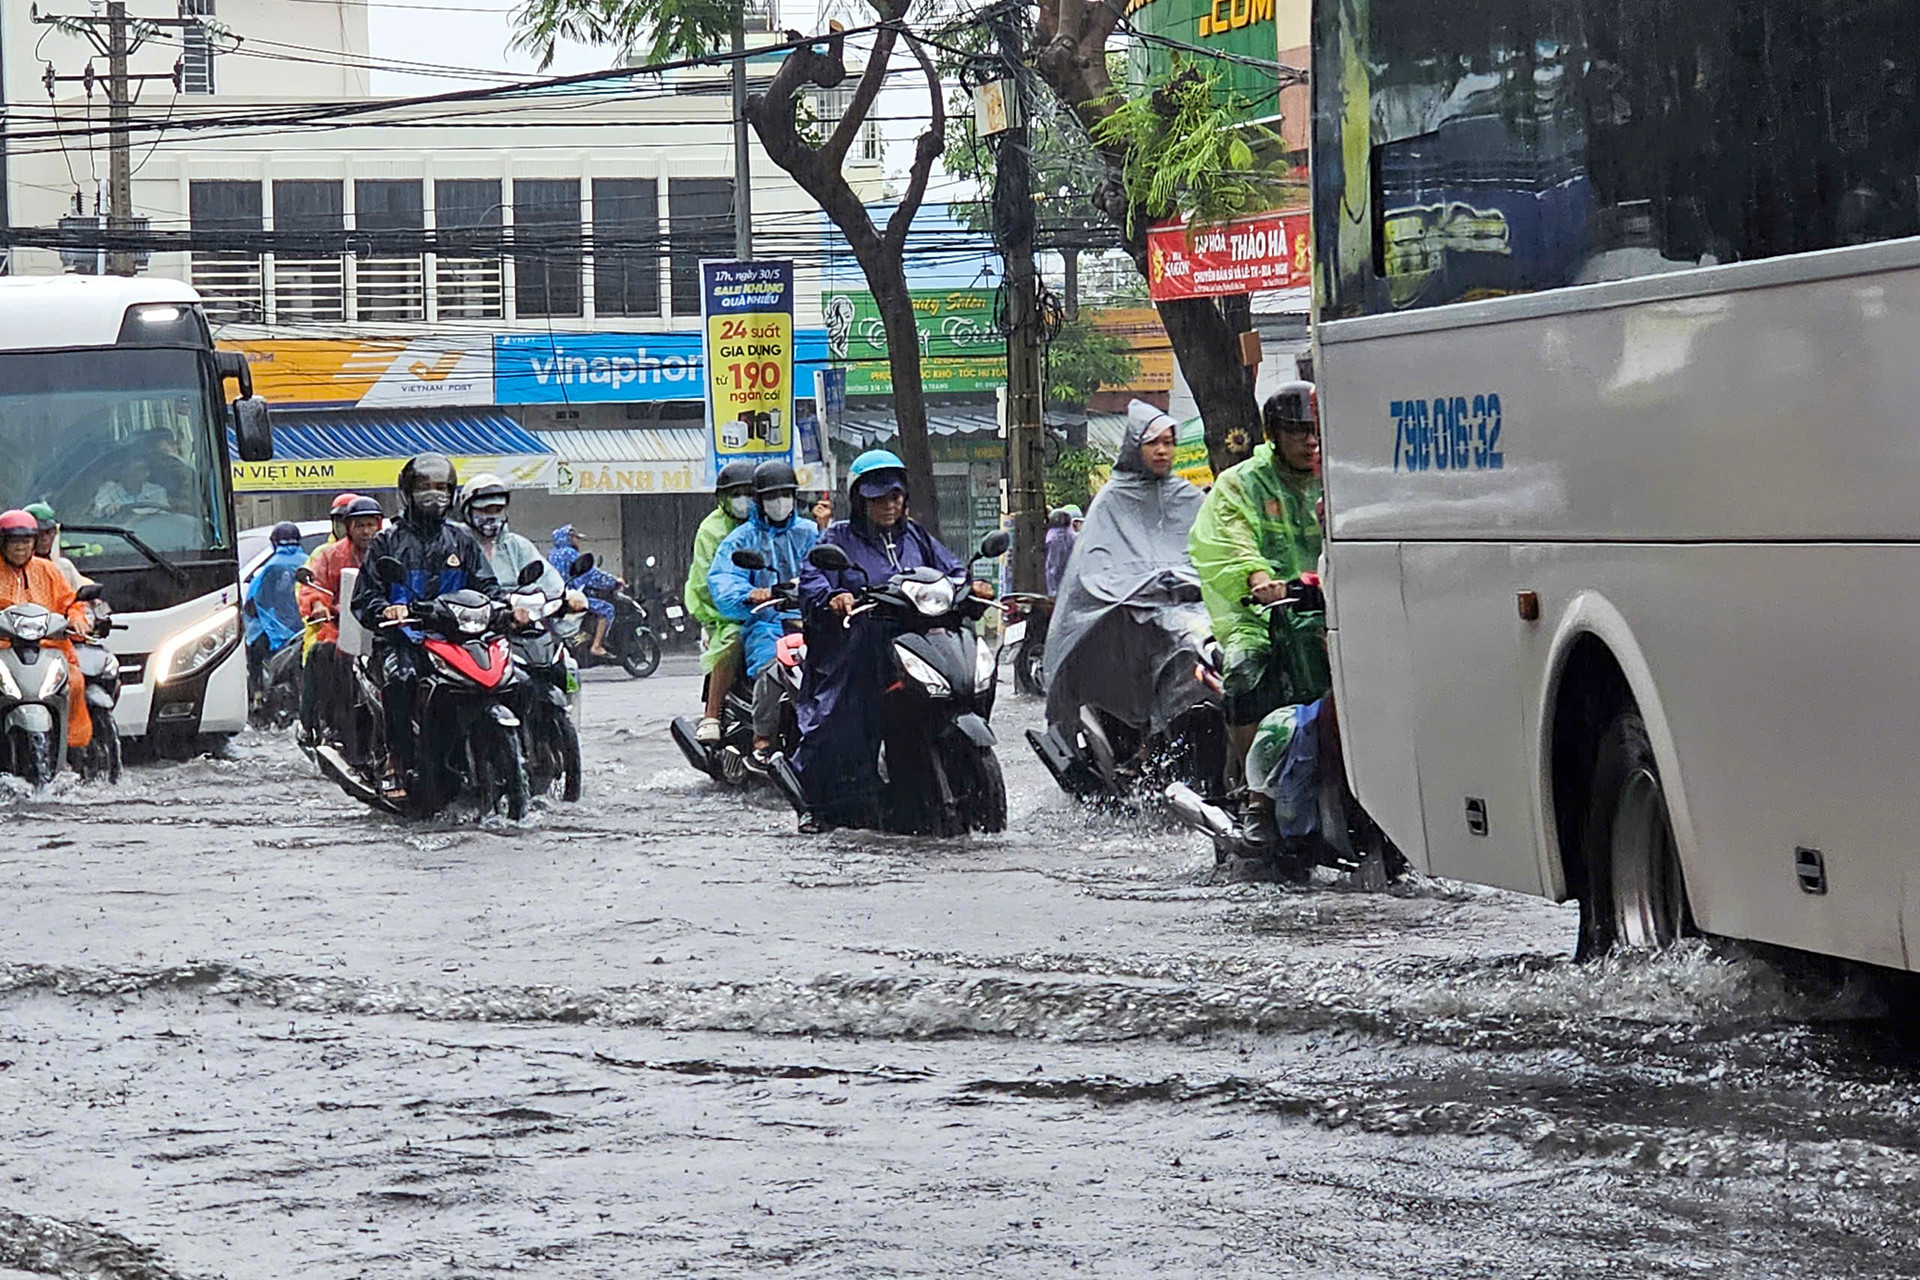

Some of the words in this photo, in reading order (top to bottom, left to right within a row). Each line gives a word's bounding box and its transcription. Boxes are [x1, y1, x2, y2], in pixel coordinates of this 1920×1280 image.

[1230, 225, 1266, 261] THẢO
[1268, 221, 1288, 257] HÀ
[759, 269, 780, 279] 30/5
[713, 285, 743, 296] SALE
[720, 320, 747, 340] 24
[751, 322, 780, 338] suất
[720, 346, 745, 358] GIA
[748, 344, 782, 359] DỤNG
[531, 346, 703, 389] vinaphon
[728, 362, 780, 390] 190
[250, 466, 288, 481] VIỆT
[295, 465, 334, 477] NAM
[579, 466, 653, 489] BÁNH
[662, 467, 692, 489] MÌ
